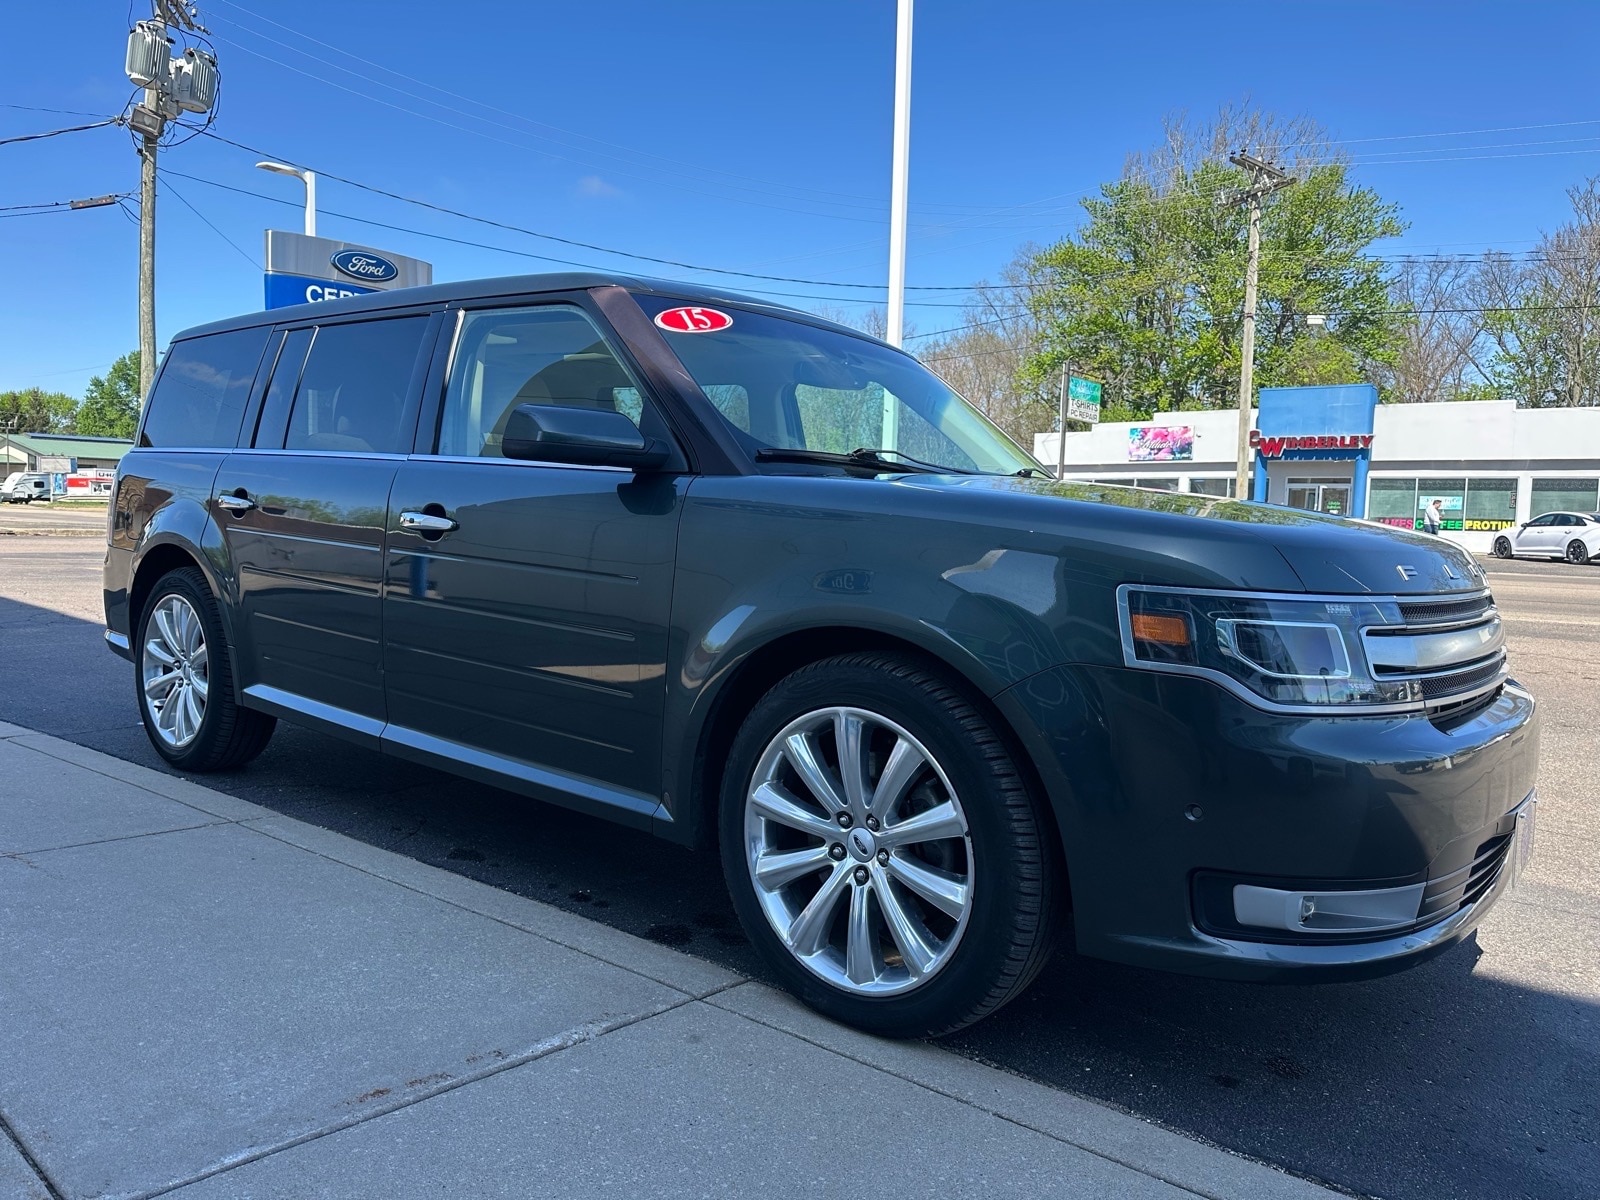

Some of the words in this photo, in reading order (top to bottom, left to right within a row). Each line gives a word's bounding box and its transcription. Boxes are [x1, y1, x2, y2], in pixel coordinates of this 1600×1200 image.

[347, 256, 385, 276] Ford
[676, 308, 711, 331] 15
[1070, 408, 1078, 416] PC
[1079, 411, 1098, 421] REPAIR
[1260, 435, 1374, 457] WIMBERLEY
[1415, 519, 1463, 530] CFEE
